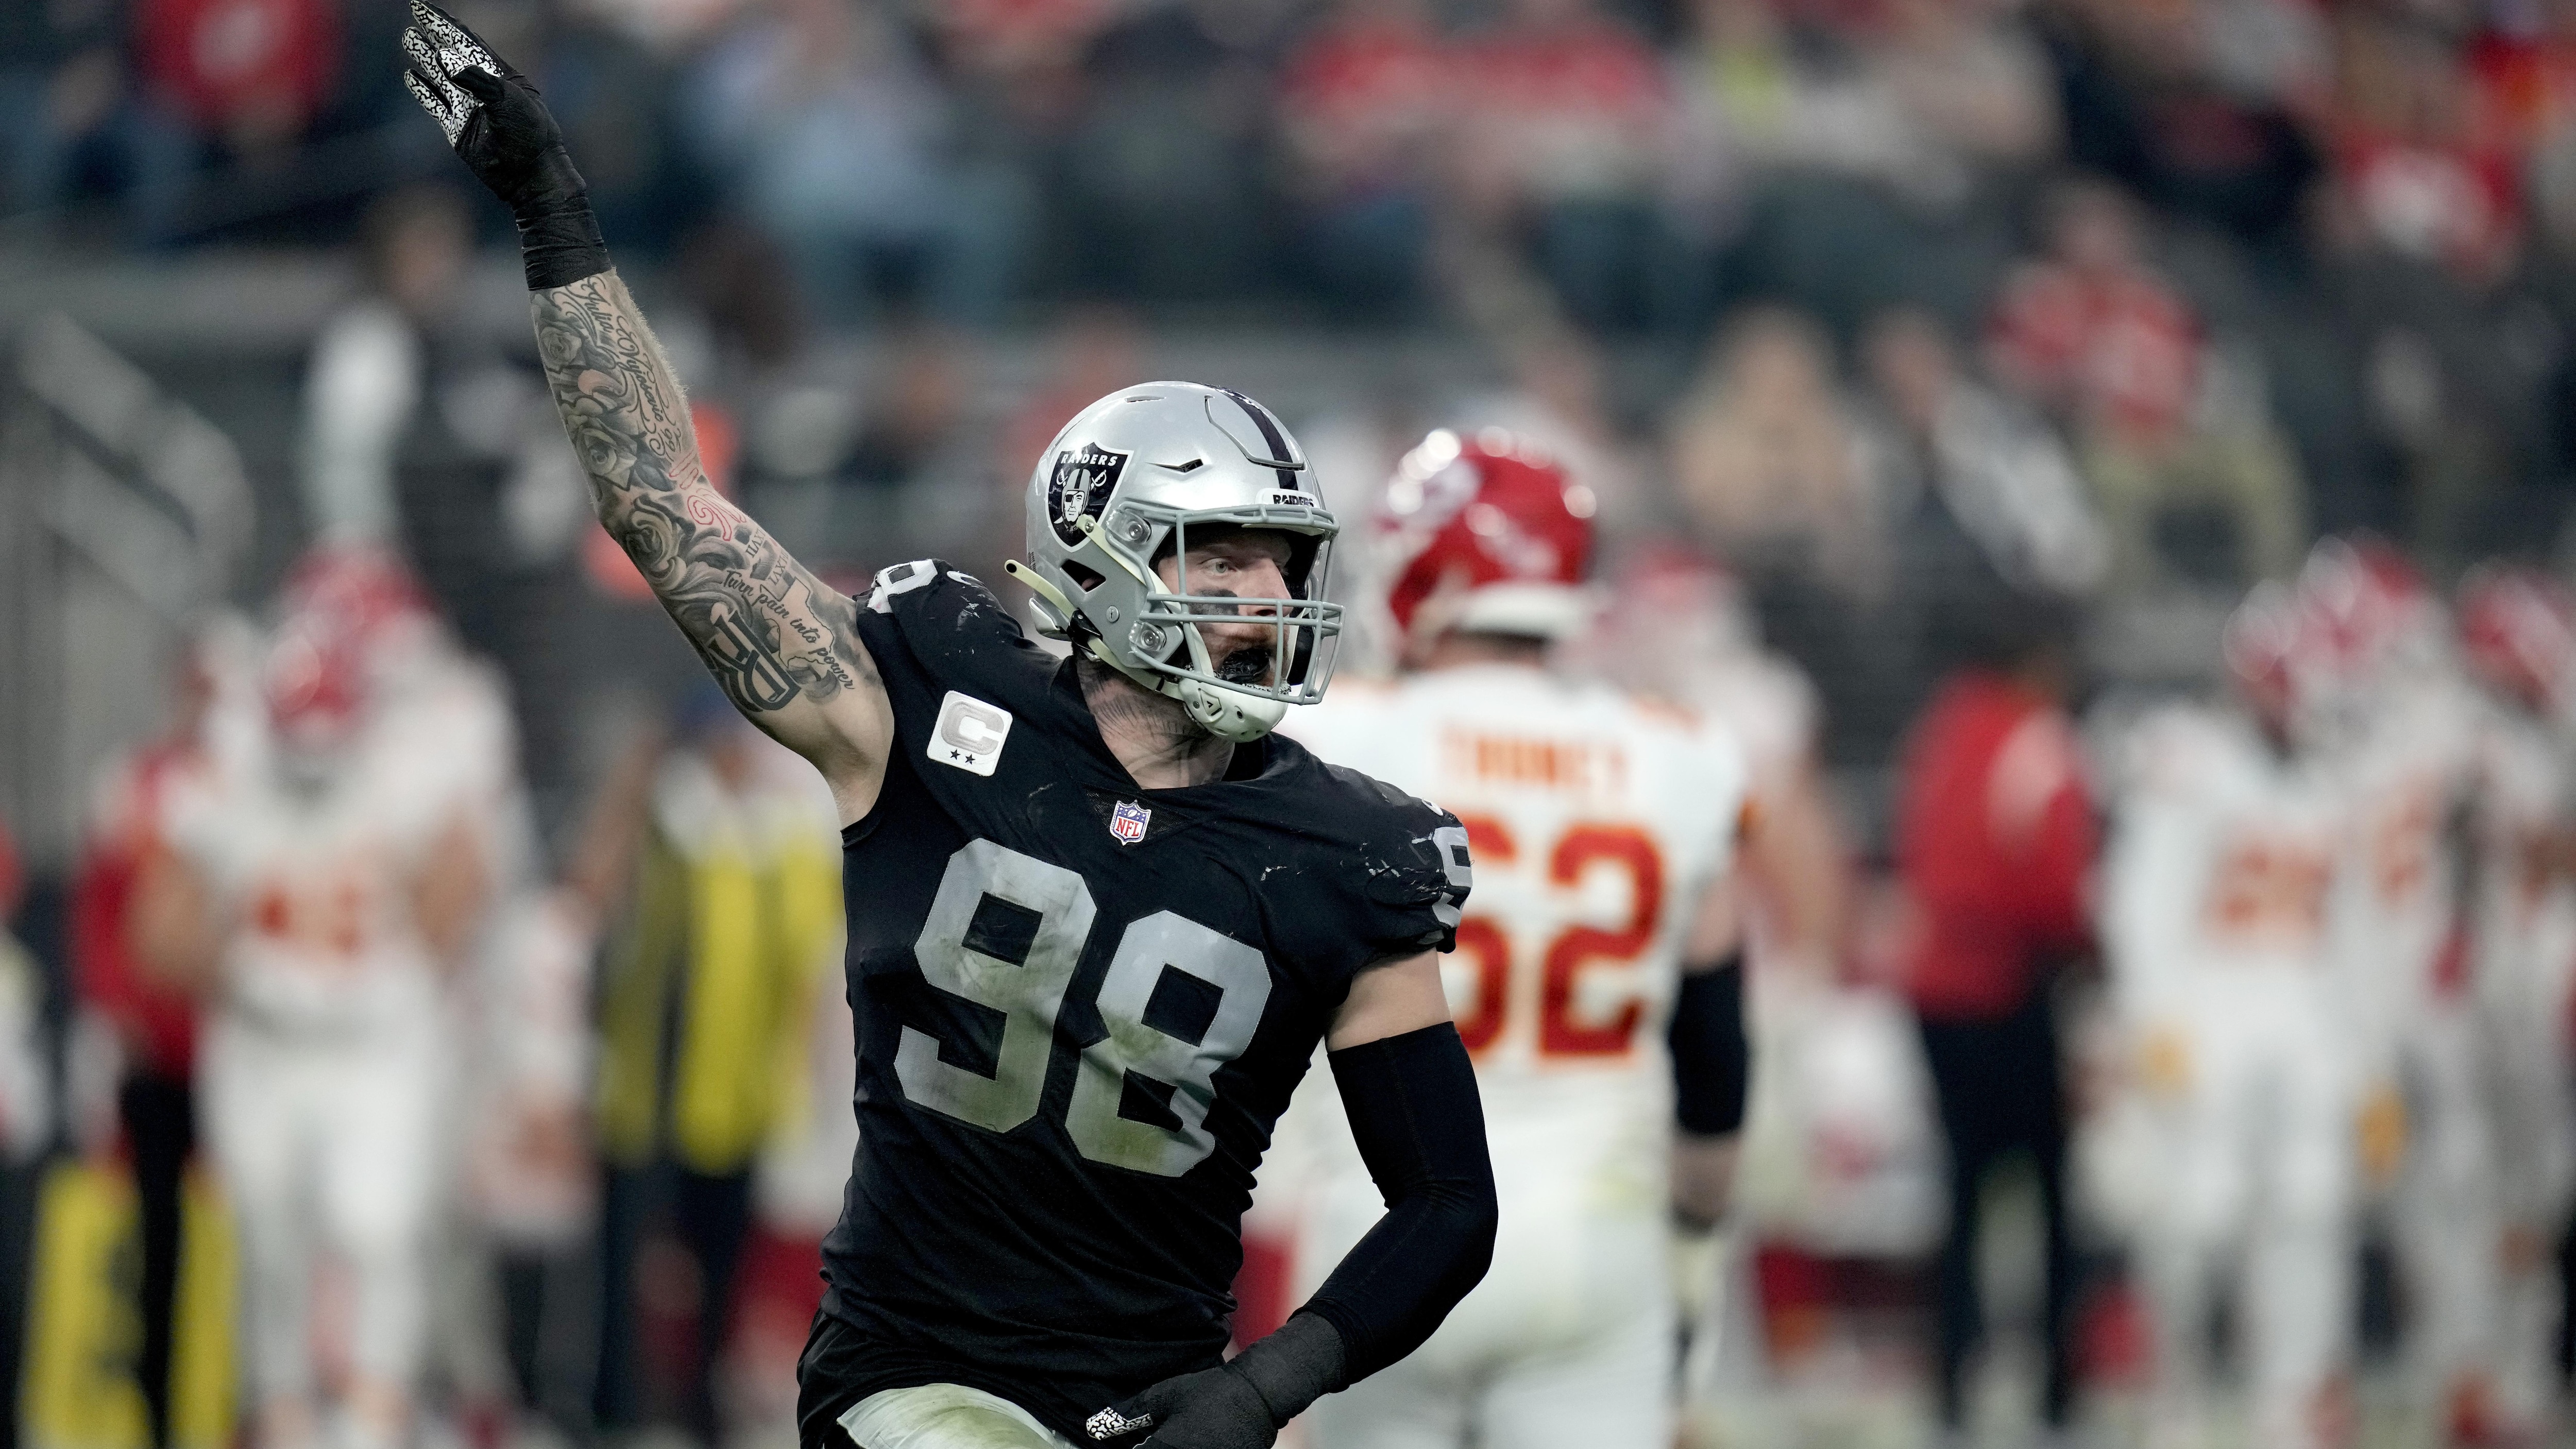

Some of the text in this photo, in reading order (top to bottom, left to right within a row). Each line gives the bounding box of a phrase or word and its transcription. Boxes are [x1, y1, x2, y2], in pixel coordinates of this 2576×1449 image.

[1060, 453, 1118, 466] RAIDERS
[1273, 494, 1314, 507] RAIDERS
[723, 570, 855, 689] Turn pain into power
[941, 701, 1004, 755] C
[1115, 817, 1139, 837] NFL
[893, 837, 1273, 1178] 98
